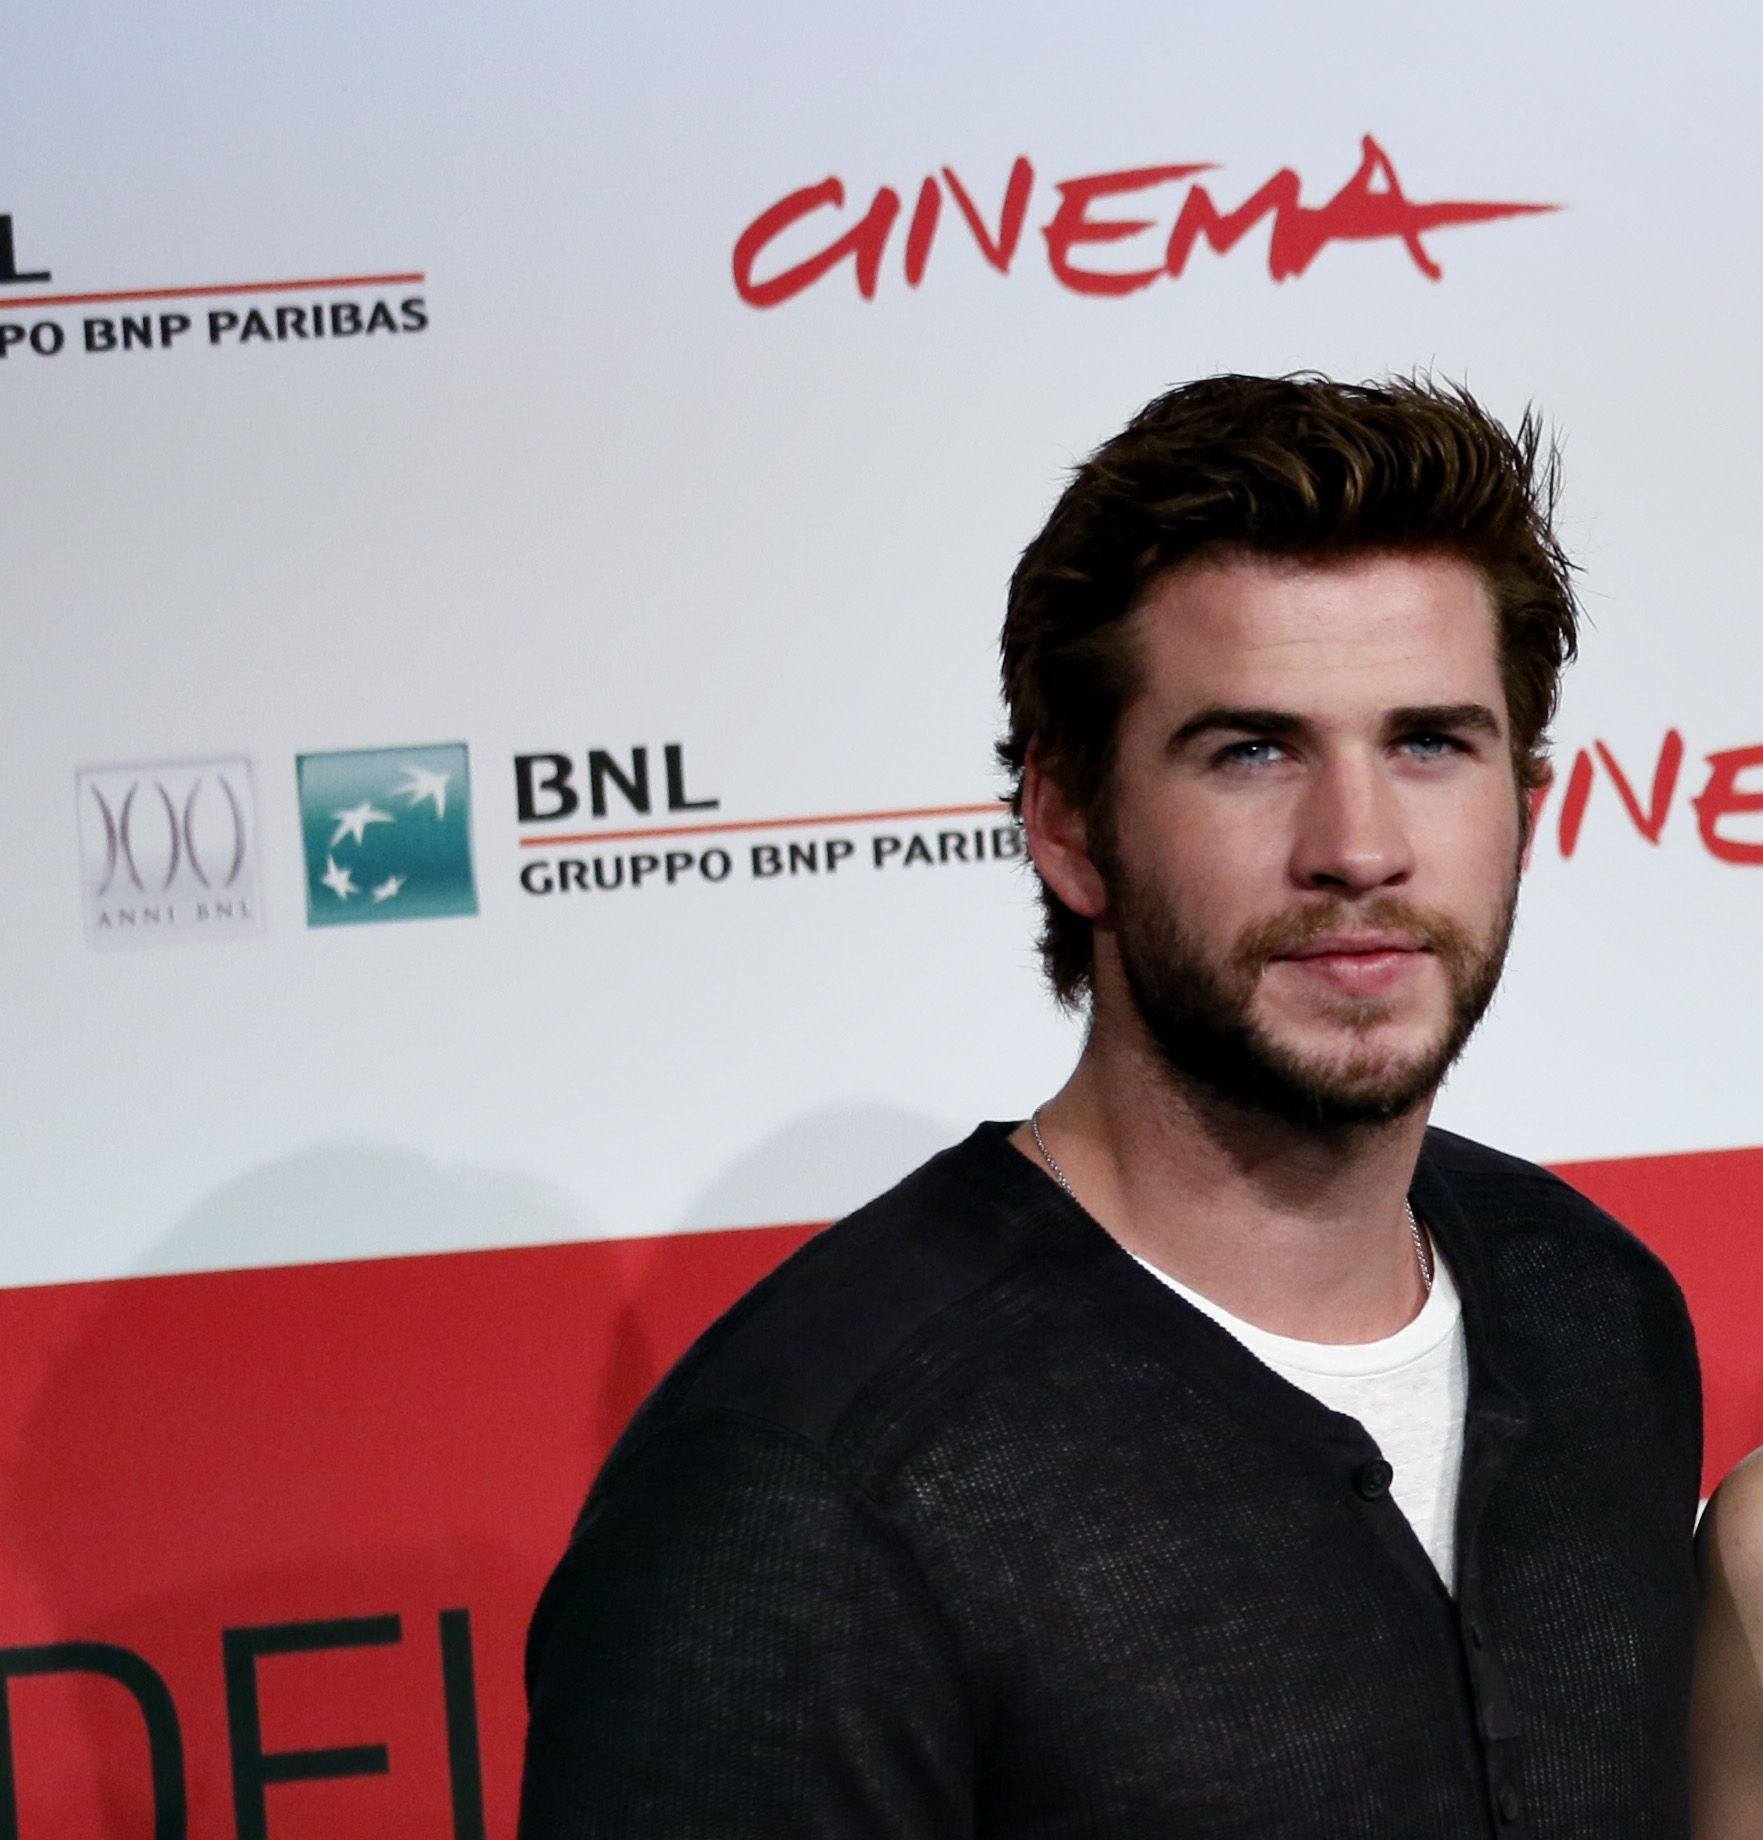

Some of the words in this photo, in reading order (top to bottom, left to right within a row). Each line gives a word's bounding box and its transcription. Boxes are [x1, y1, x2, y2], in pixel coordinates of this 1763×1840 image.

[731, 133, 1566, 310] CINEMA
[82, 312, 193, 353] BNP
[206, 297, 430, 346] PARIBAS
[511, 742, 721, 825] BNL
[517, 847, 733, 897] GRUPPO
[749, 838, 856, 879] BNP
[871, 825, 1023, 870] PARIB
